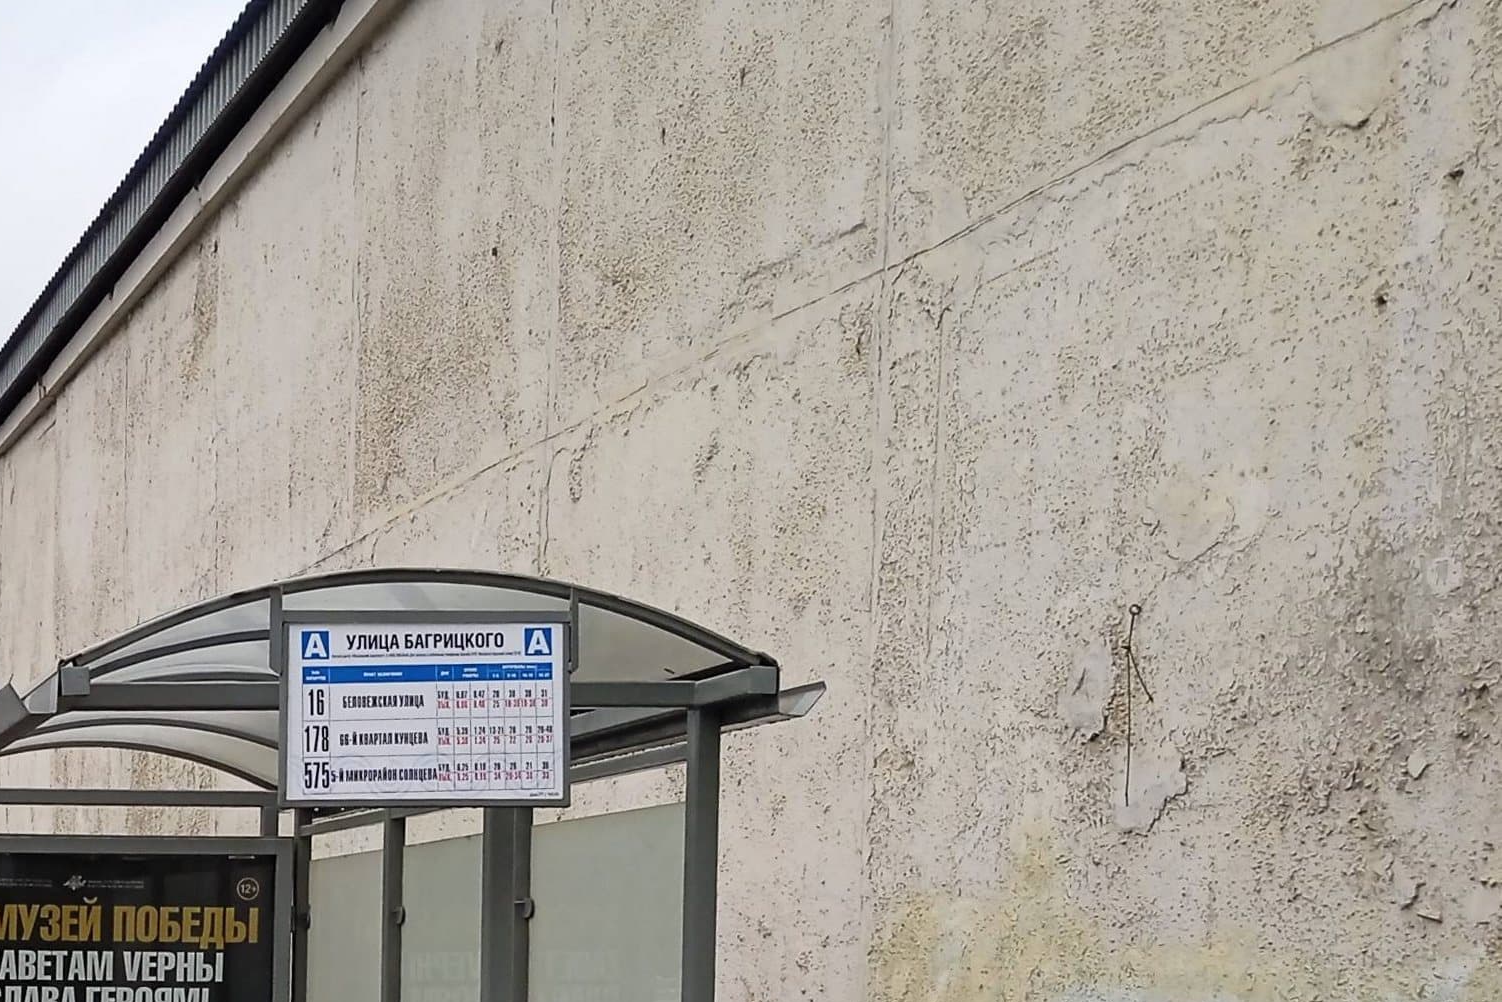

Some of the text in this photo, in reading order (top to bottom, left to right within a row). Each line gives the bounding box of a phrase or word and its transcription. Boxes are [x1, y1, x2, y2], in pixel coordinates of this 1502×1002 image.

[346, 632, 504, 652] УЛИЦА БАГРИЦКОГО
[308, 689, 324, 716] 16
[342, 694, 425, 709] БЕЛОВЕЖСКАЯ УЛИЦА
[304, 725, 329, 752] 178
[359, 732, 393, 745] КВАРТАЛ
[394, 732, 428, 746] КУНЦЕВА
[304, 762, 330, 789] 575
[331, 767, 438, 782] 5-Й МИКРОРАЙОН СОЛНЦЕВА
[240, 884, 257, 894] 12+
[113, 905, 259, 949] ПОБЕДЫ
